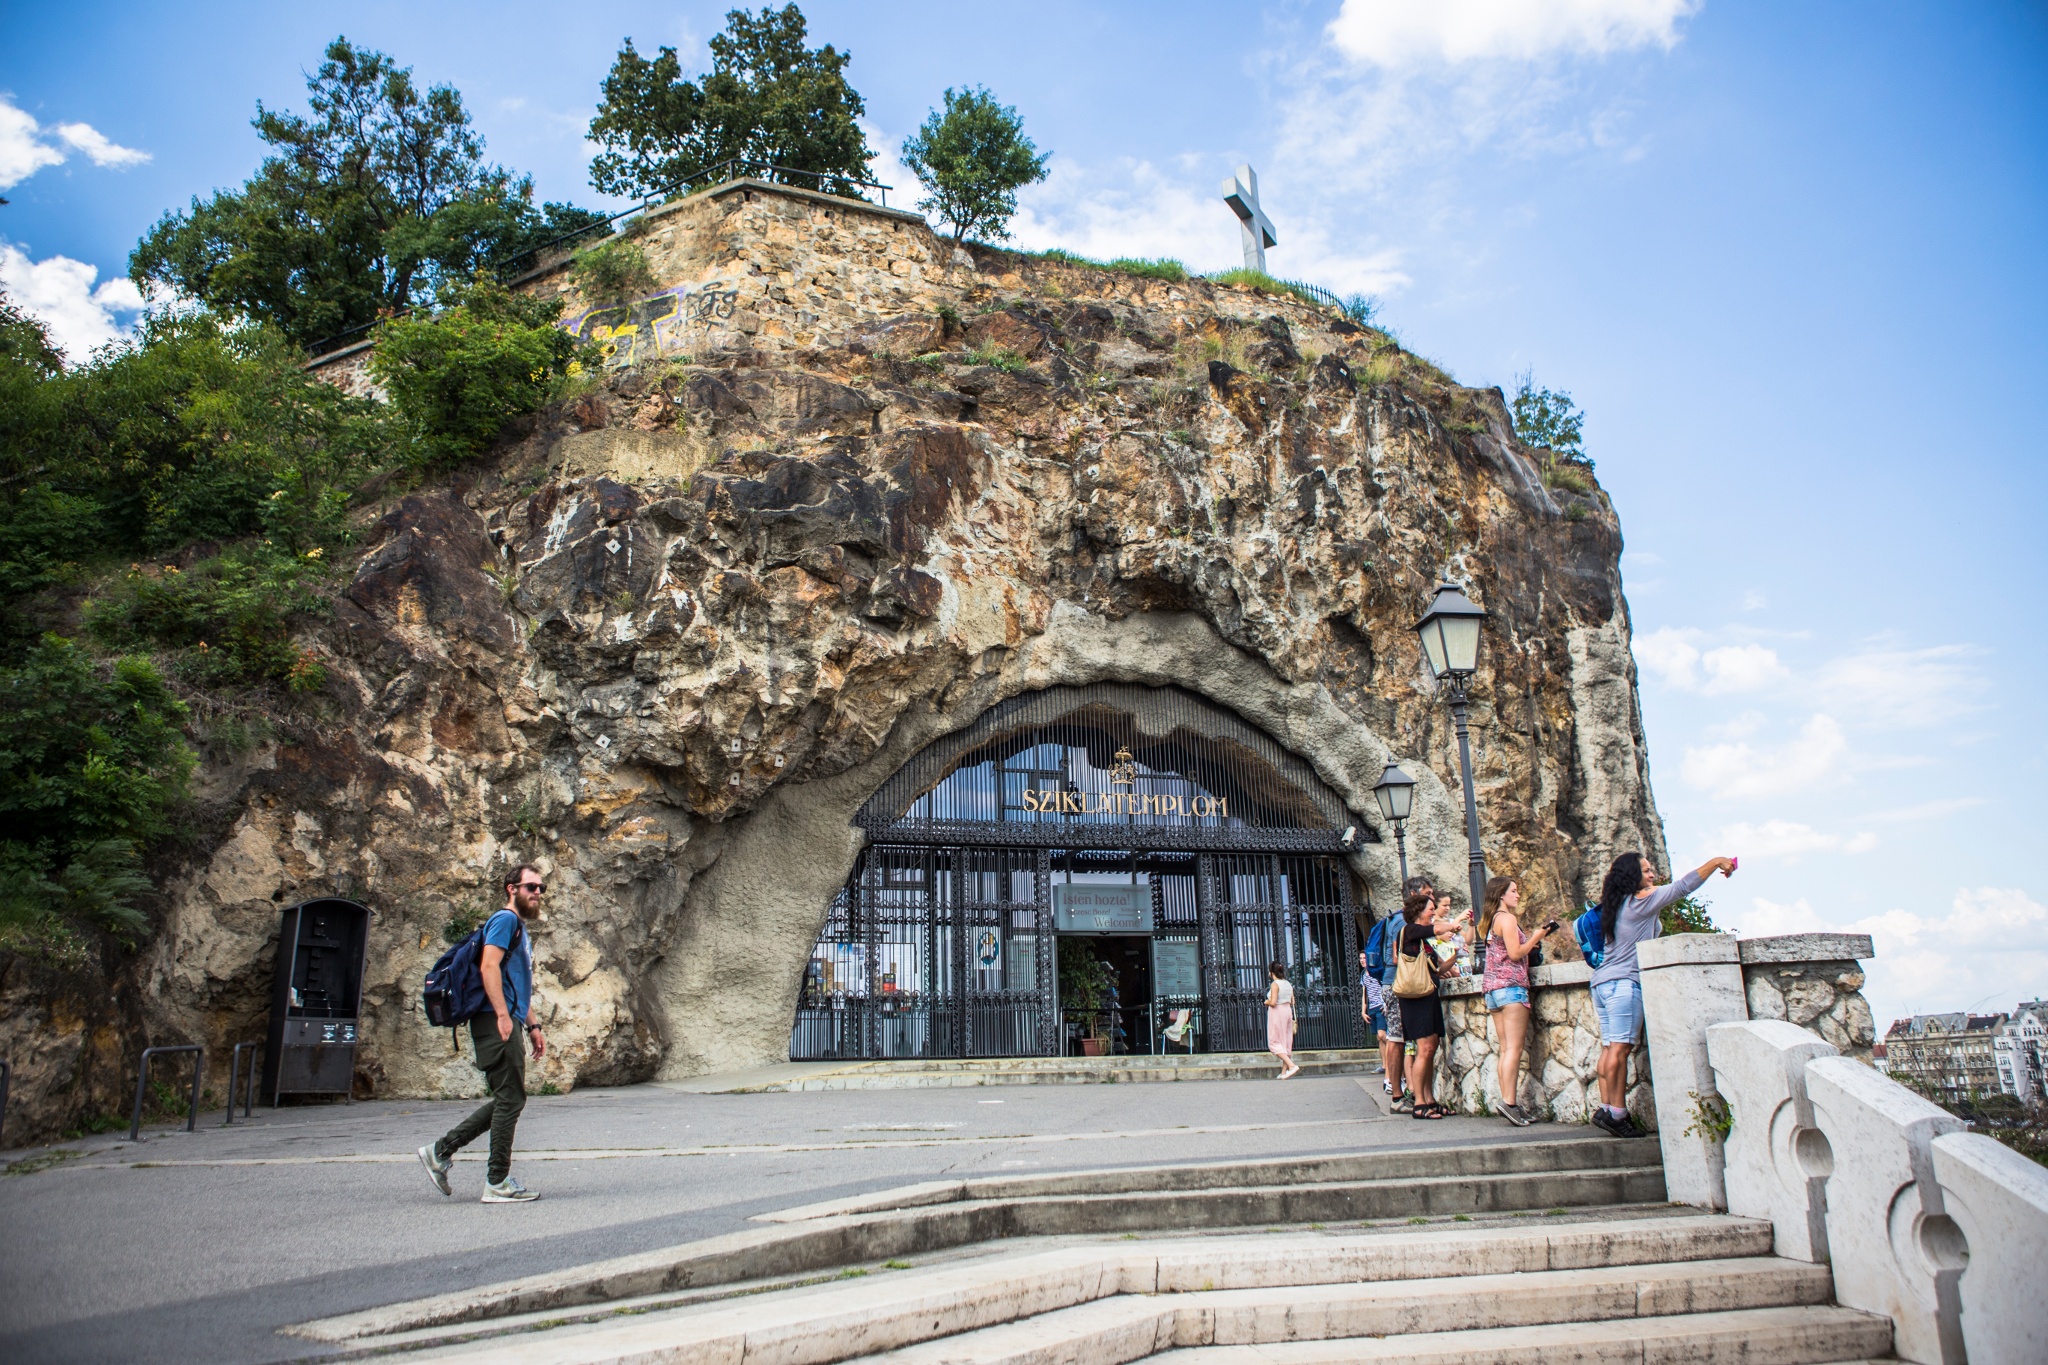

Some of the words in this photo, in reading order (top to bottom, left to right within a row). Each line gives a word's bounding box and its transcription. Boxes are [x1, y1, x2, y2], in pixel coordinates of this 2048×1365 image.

[1023, 789, 1229, 818] SZIKLATEMPLOM
[1063, 893, 1092, 905] Isten
[1095, 893, 1131, 906] hozta!
[1094, 917, 1144, 928] Welcome!
